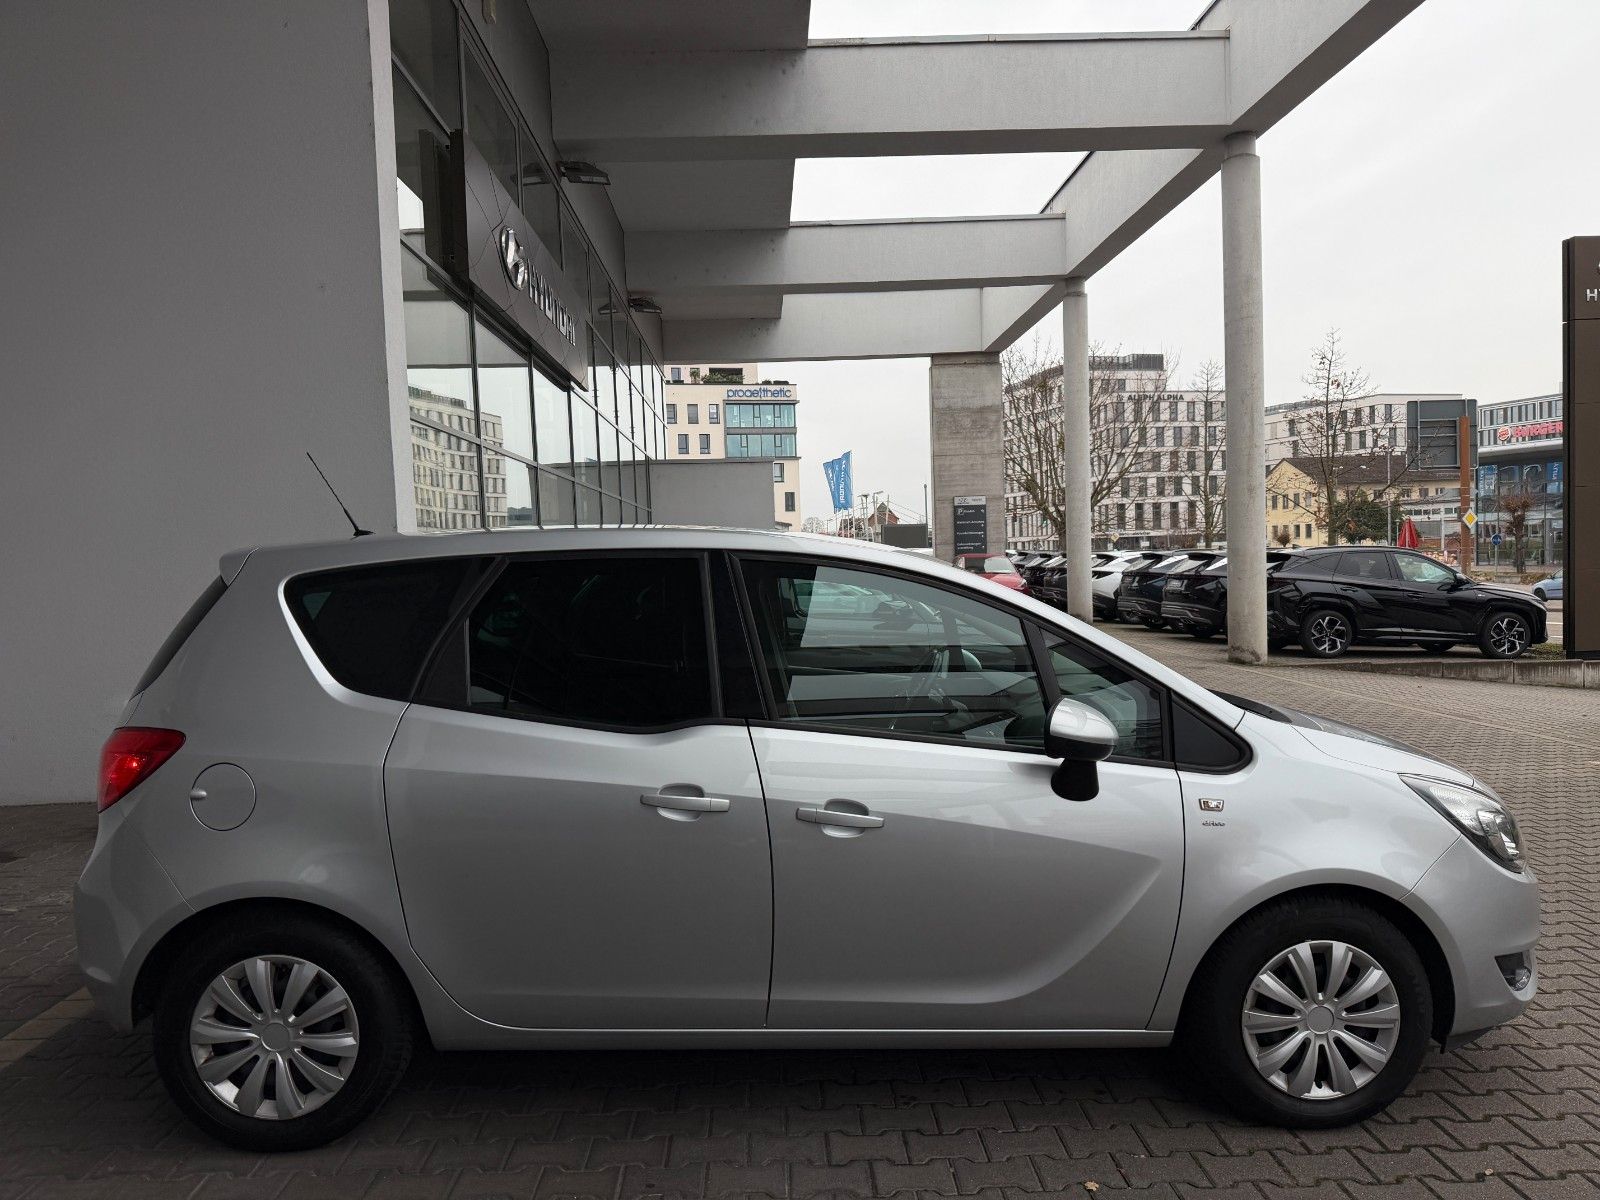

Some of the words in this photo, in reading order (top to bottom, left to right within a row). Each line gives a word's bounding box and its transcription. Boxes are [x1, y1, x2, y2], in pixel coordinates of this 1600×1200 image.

[1586, 288, 1600, 301] H
[527, 259, 576, 346] HYUNDAI
[1127, 393, 1155, 401] ALEPH
[1157, 393, 1185, 401] ALPHA
